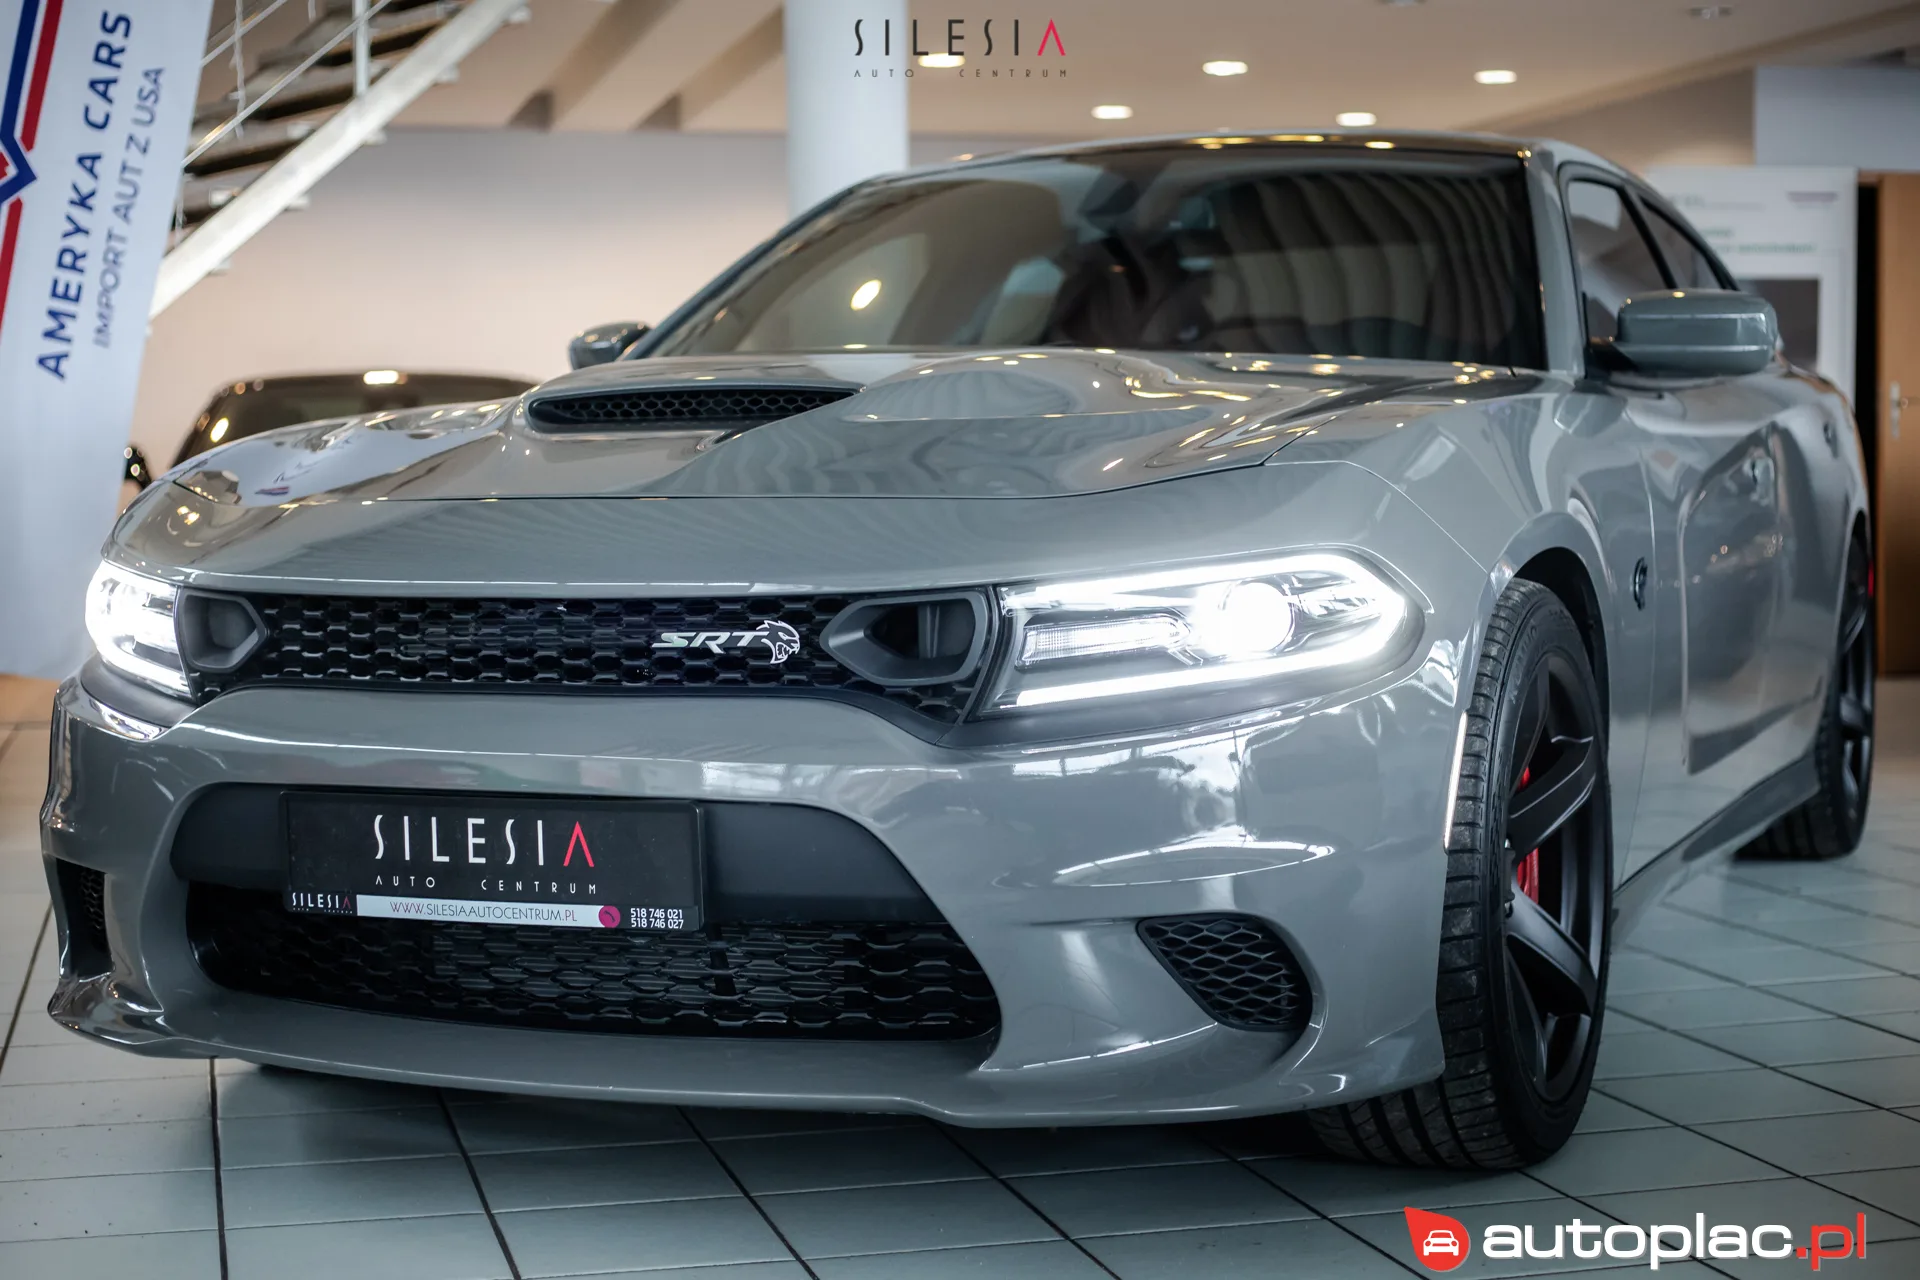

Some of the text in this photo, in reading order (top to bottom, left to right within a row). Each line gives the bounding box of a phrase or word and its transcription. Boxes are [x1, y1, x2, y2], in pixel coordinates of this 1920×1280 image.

[36, 10, 132, 382] AMERYKA CARS
[93, 66, 165, 348] IMPORT AUT Z USA
[651, 631, 769, 654] SRT
[374, 814, 595, 867] SILESIA
[375, 875, 596, 895] AUTO CENTRUM
[292, 892, 352, 909] SILESIA
[389, 901, 578, 922] WWW.SILESIAAUTOCENTRUM.PL
[630, 907, 683, 919] 518 746 021
[631, 917, 684, 929] 518 746 027
